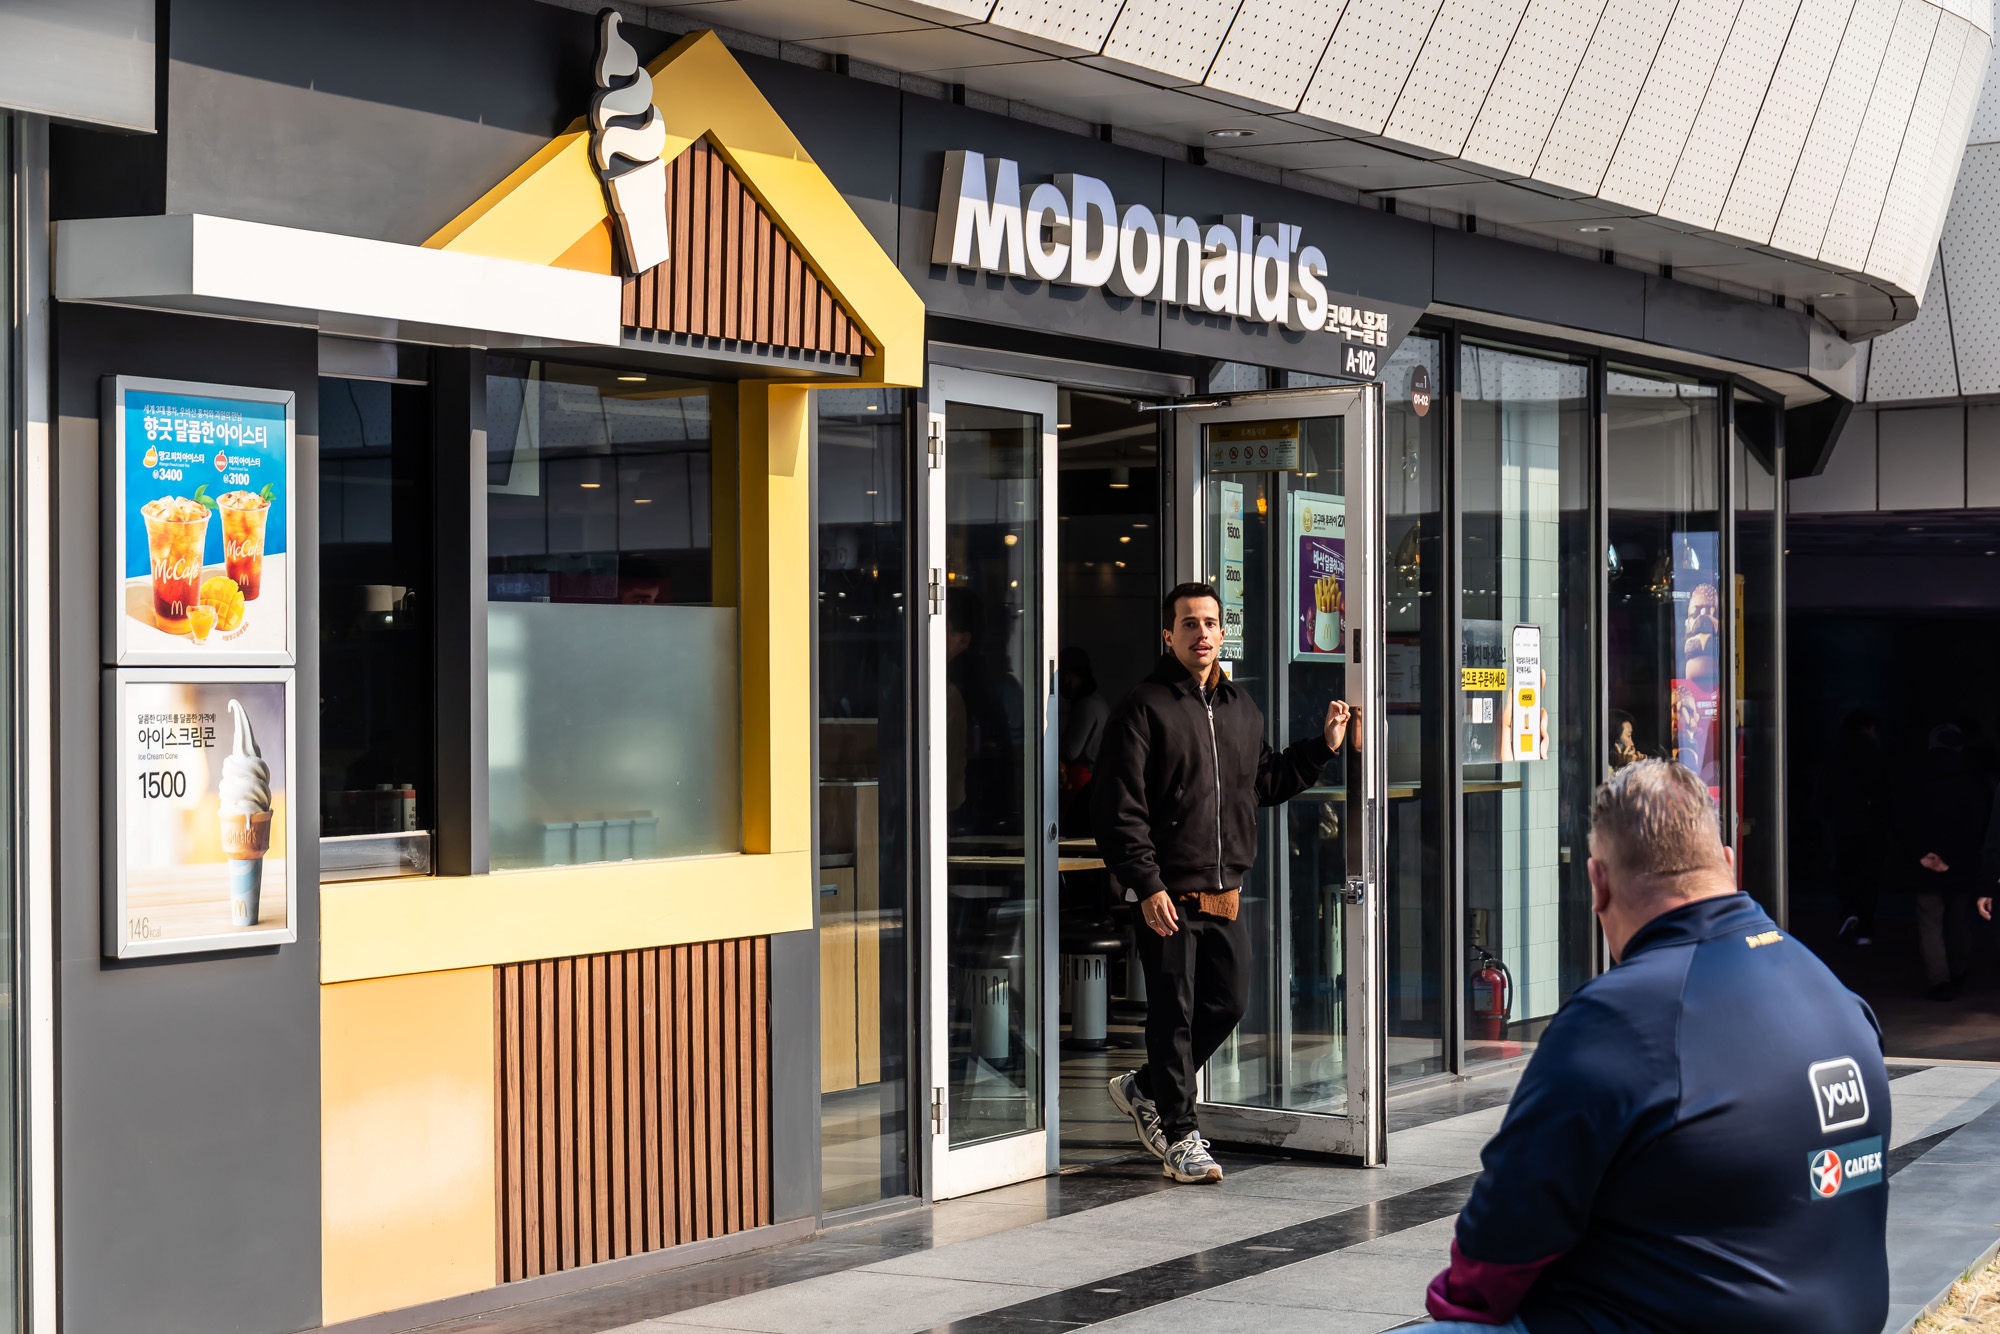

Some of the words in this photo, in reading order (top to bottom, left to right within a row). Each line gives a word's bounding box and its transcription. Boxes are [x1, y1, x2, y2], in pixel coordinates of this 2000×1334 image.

[934, 150, 1329, 331] McDonald's
[1324, 303, 1388, 347] 코엑스몰점
[1345, 347, 1376, 377] A-102
[1413, 393, 1429, 406] 01-02
[143, 415, 173, 441] 향긋
[174, 418, 215, 444] 달콤한
[216, 422, 267, 449] 아이스티
[158, 467, 183, 482] 3400
[228, 472, 250, 486] 3100
[1478, 671, 1505, 687] 주문하세요
[138, 726, 216, 750] 아이스크림콘
[146, 752, 164, 760] Cream
[138, 770, 186, 799] 1500
[1821, 1069, 1860, 1119] youi
[1844, 1151, 1883, 1179] CALTEX
